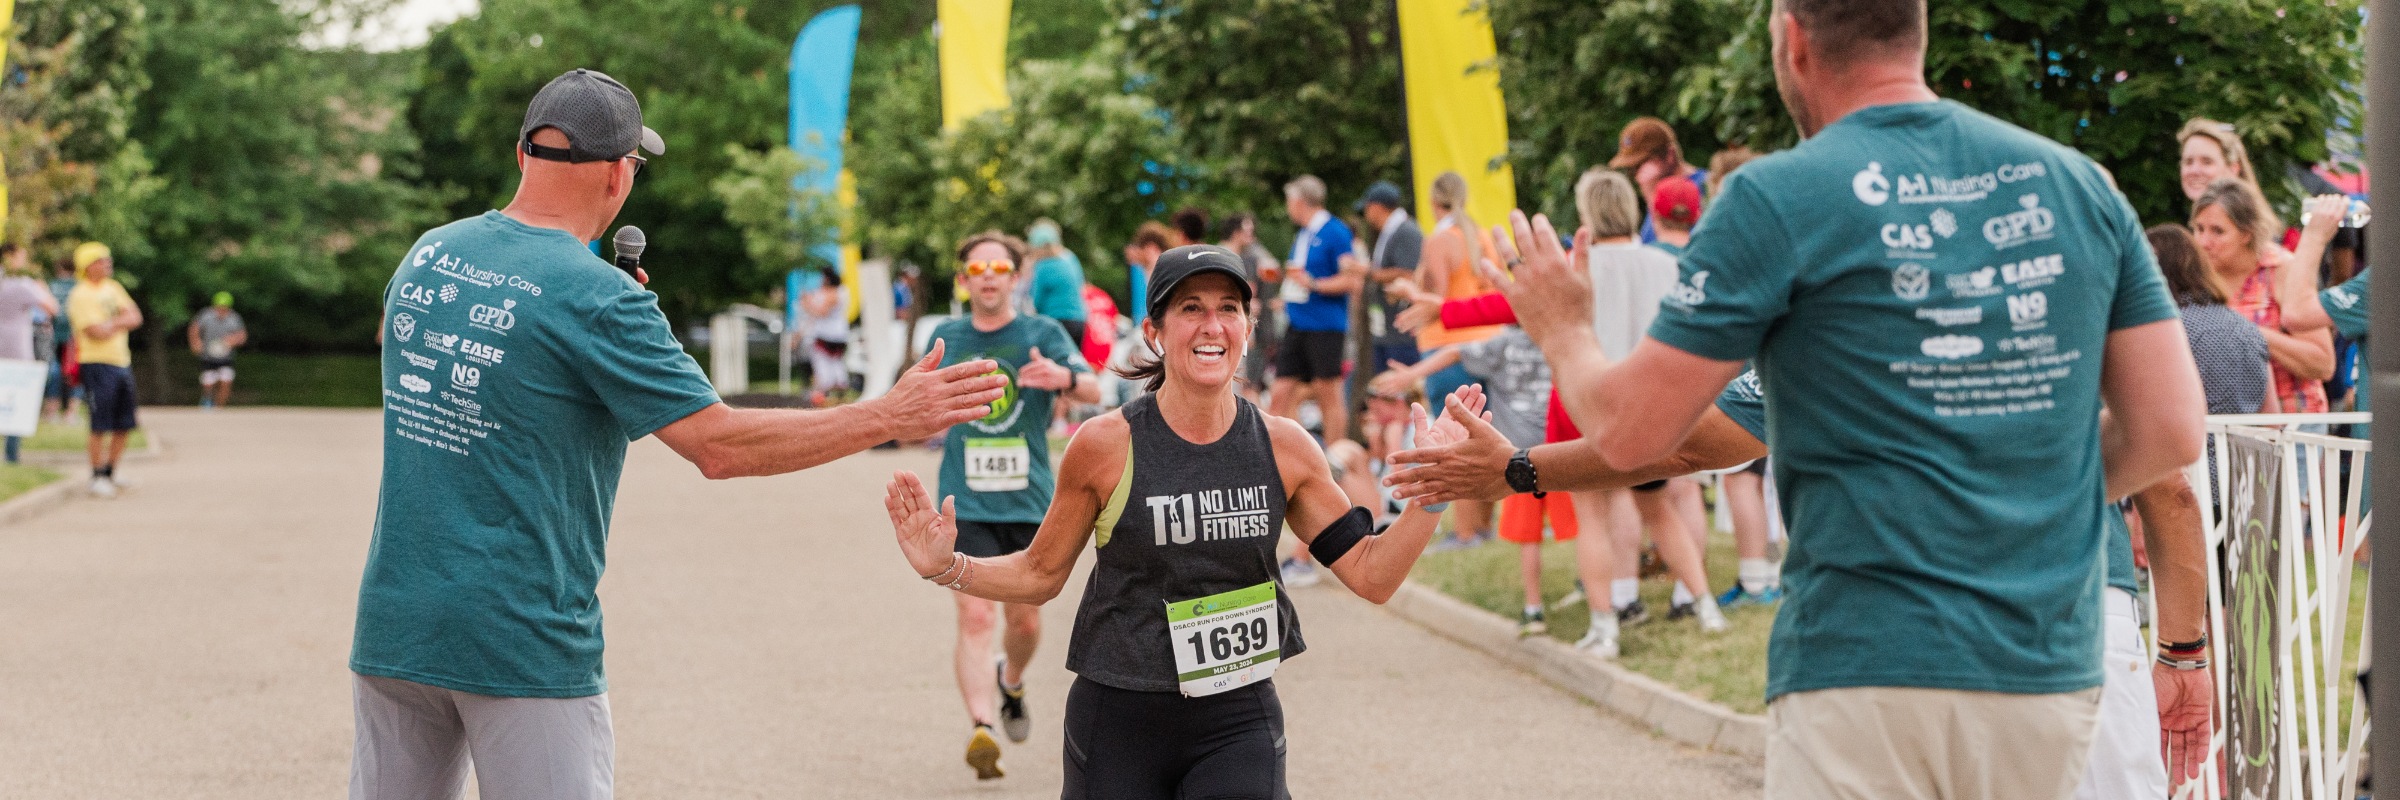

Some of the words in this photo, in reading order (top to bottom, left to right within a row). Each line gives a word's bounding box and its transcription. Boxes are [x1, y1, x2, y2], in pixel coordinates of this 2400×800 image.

[1930, 171, 1998, 193] Nursing
[1997, 161, 2046, 184] Care
[1880, 222, 1934, 250] CAS
[1982, 206, 2055, 246] GPD
[435, 253, 461, 271] A-1
[461, 262, 506, 286] Nursing
[508, 275, 542, 297] Care
[2001, 253, 2066, 285] EASE
[400, 282, 435, 306] CAS
[2006, 290, 2049, 323] N9
[469, 303, 515, 330] GPD
[460, 338, 505, 364] EASE
[465, 355, 492, 367] LOGISTICS
[451, 362, 480, 387] N9
[450, 394, 482, 411] TechSite
[975, 456, 1017, 472] 1481
[1199, 489, 1224, 514] NO
[1228, 485, 1268, 511] LIMIT
[1202, 514, 1269, 541] FITNESS
[1173, 622, 1196, 631] DSACO
[1197, 618, 1210, 626] RUN
[1225, 611, 1245, 620] DOWN
[1245, 603, 1274, 616] SYNDROME
[1187, 617, 1268, 665] 1639
[1213, 666, 1228, 675] MAY
[1229, 662, 1239, 671] 23,
[1239, 658, 1253, 667] 2024
[1213, 680, 1227, 688] CAS
